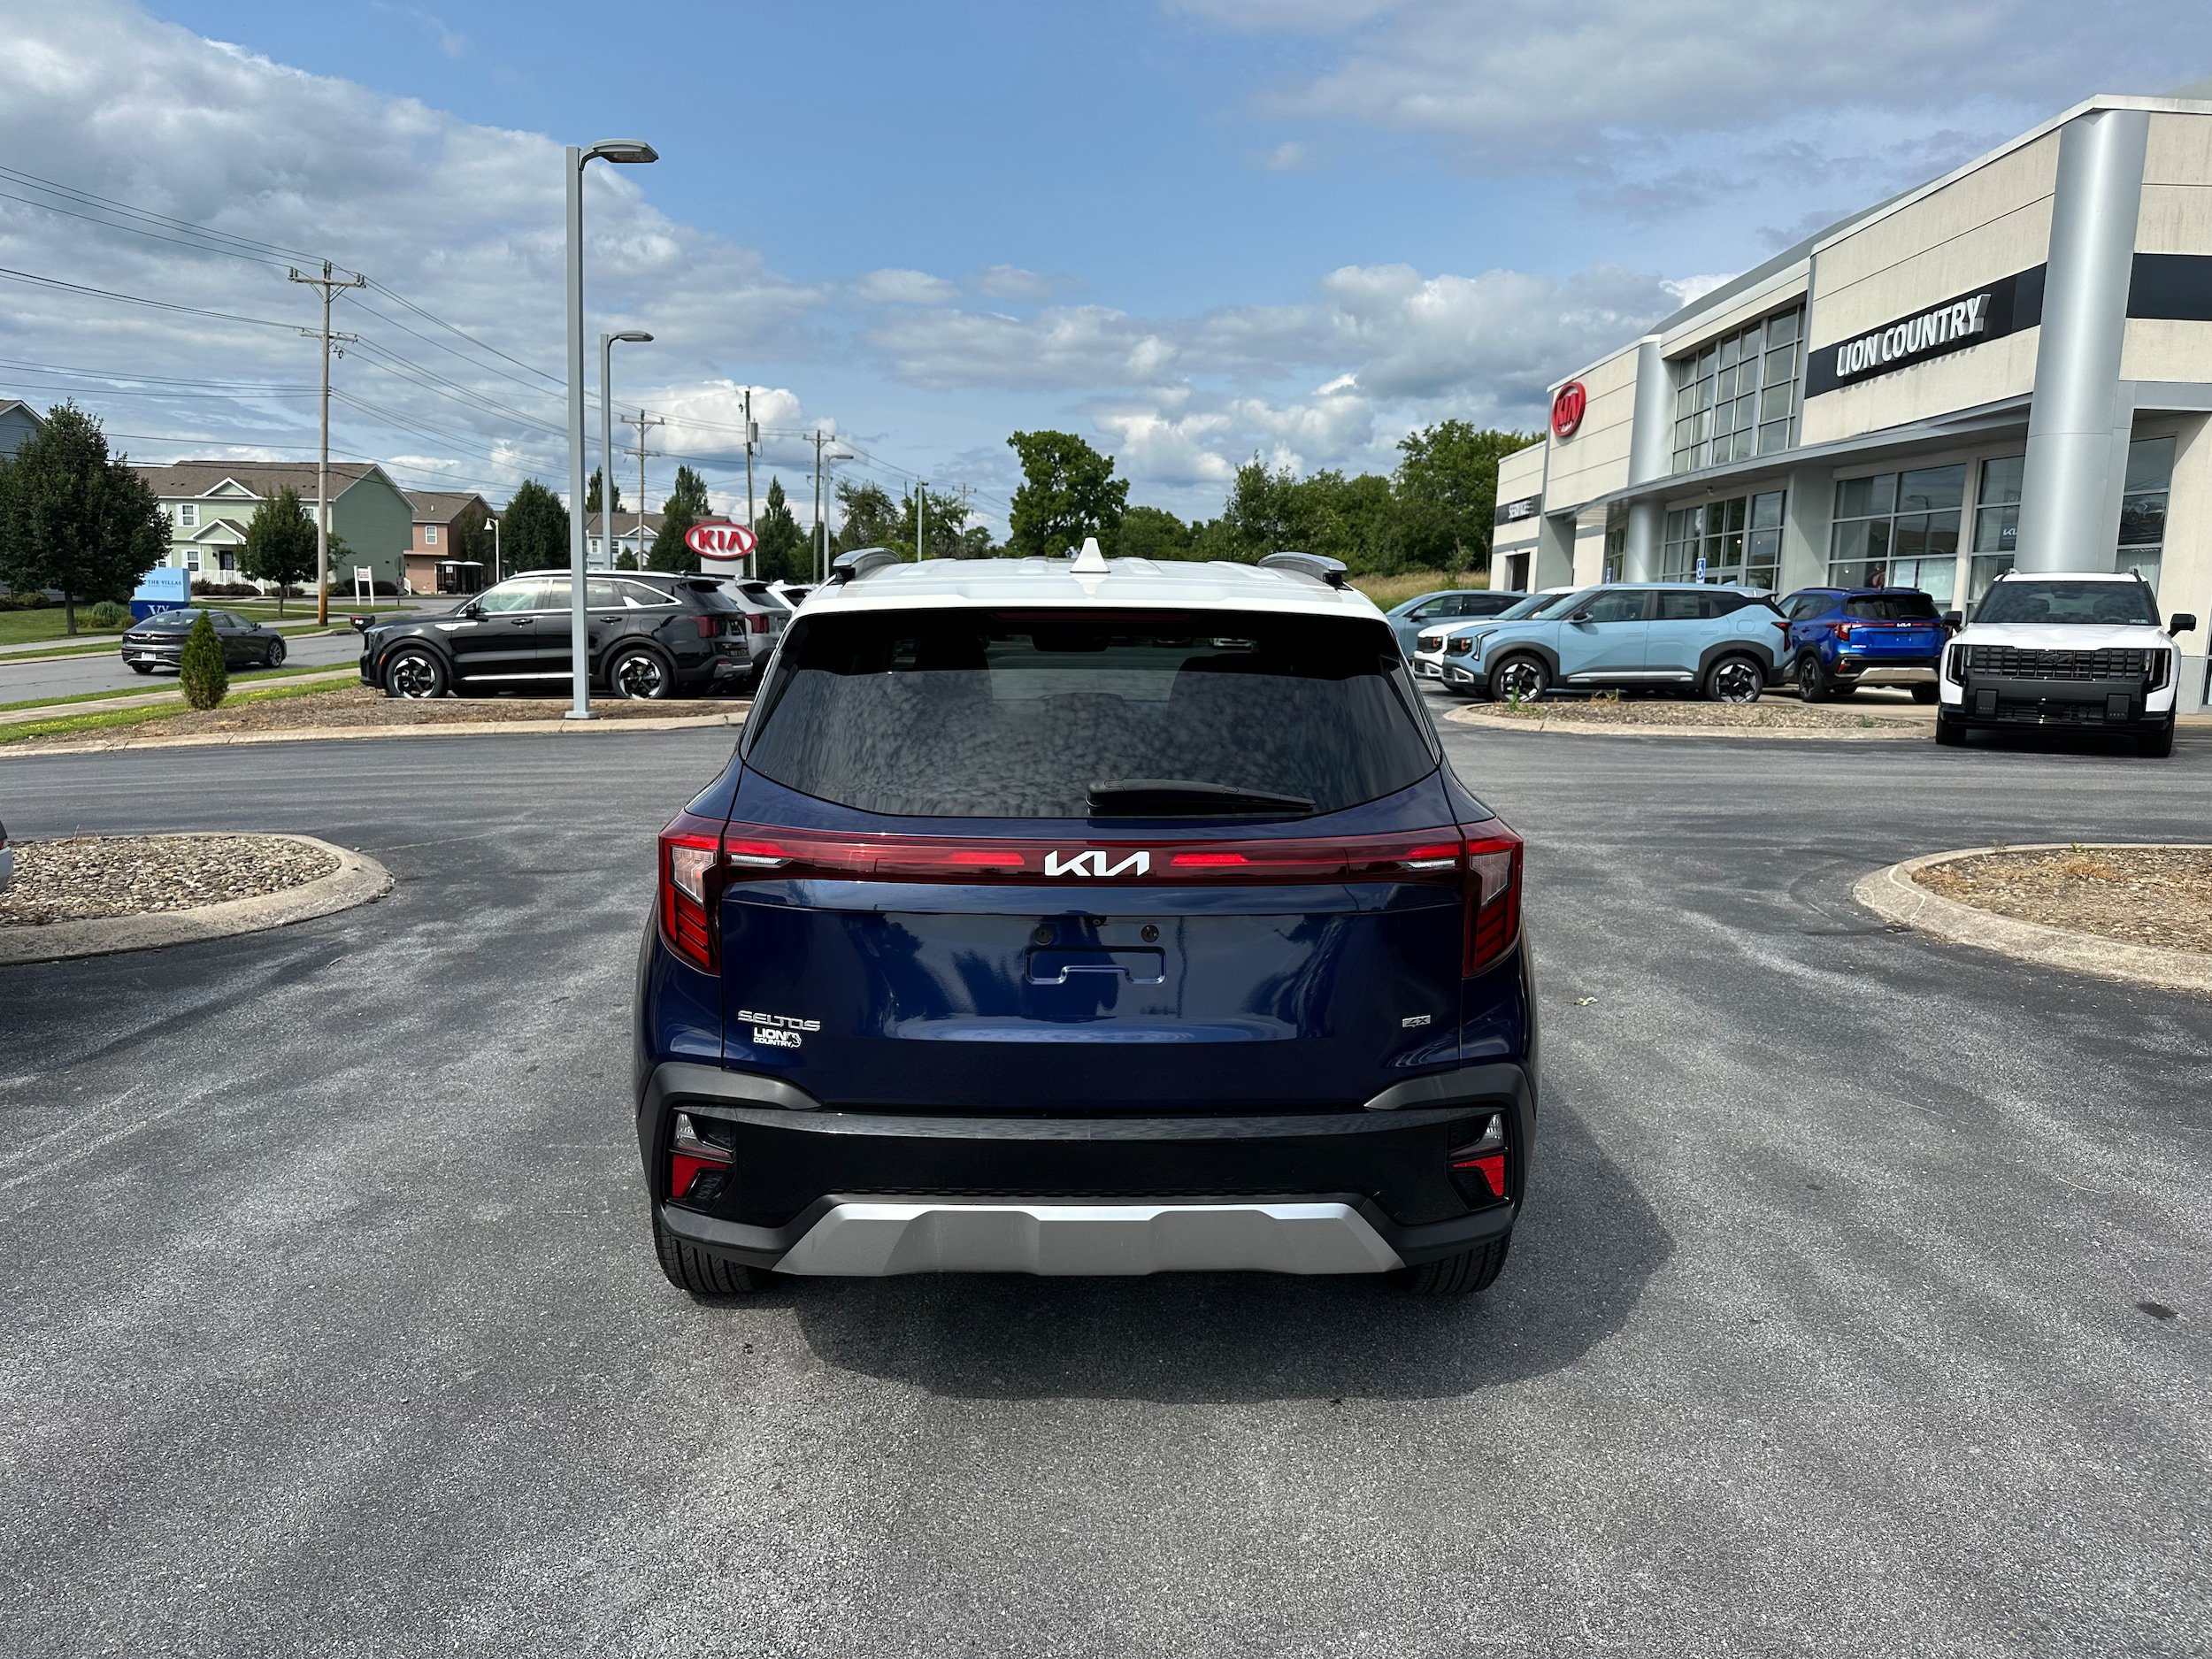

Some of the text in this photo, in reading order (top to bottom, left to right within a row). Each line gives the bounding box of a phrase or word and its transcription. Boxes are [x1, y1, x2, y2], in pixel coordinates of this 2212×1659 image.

[1836, 294, 1991, 378] LION COUNTRY
[1555, 392, 1579, 426] KIA
[697, 529, 745, 552] KIA
[1044, 849, 1150, 877] KIA
[737, 1010, 821, 1033] SELTOS
[753, 1026, 787, 1041] LION
[753, 1036, 795, 1048] COUNTRY
